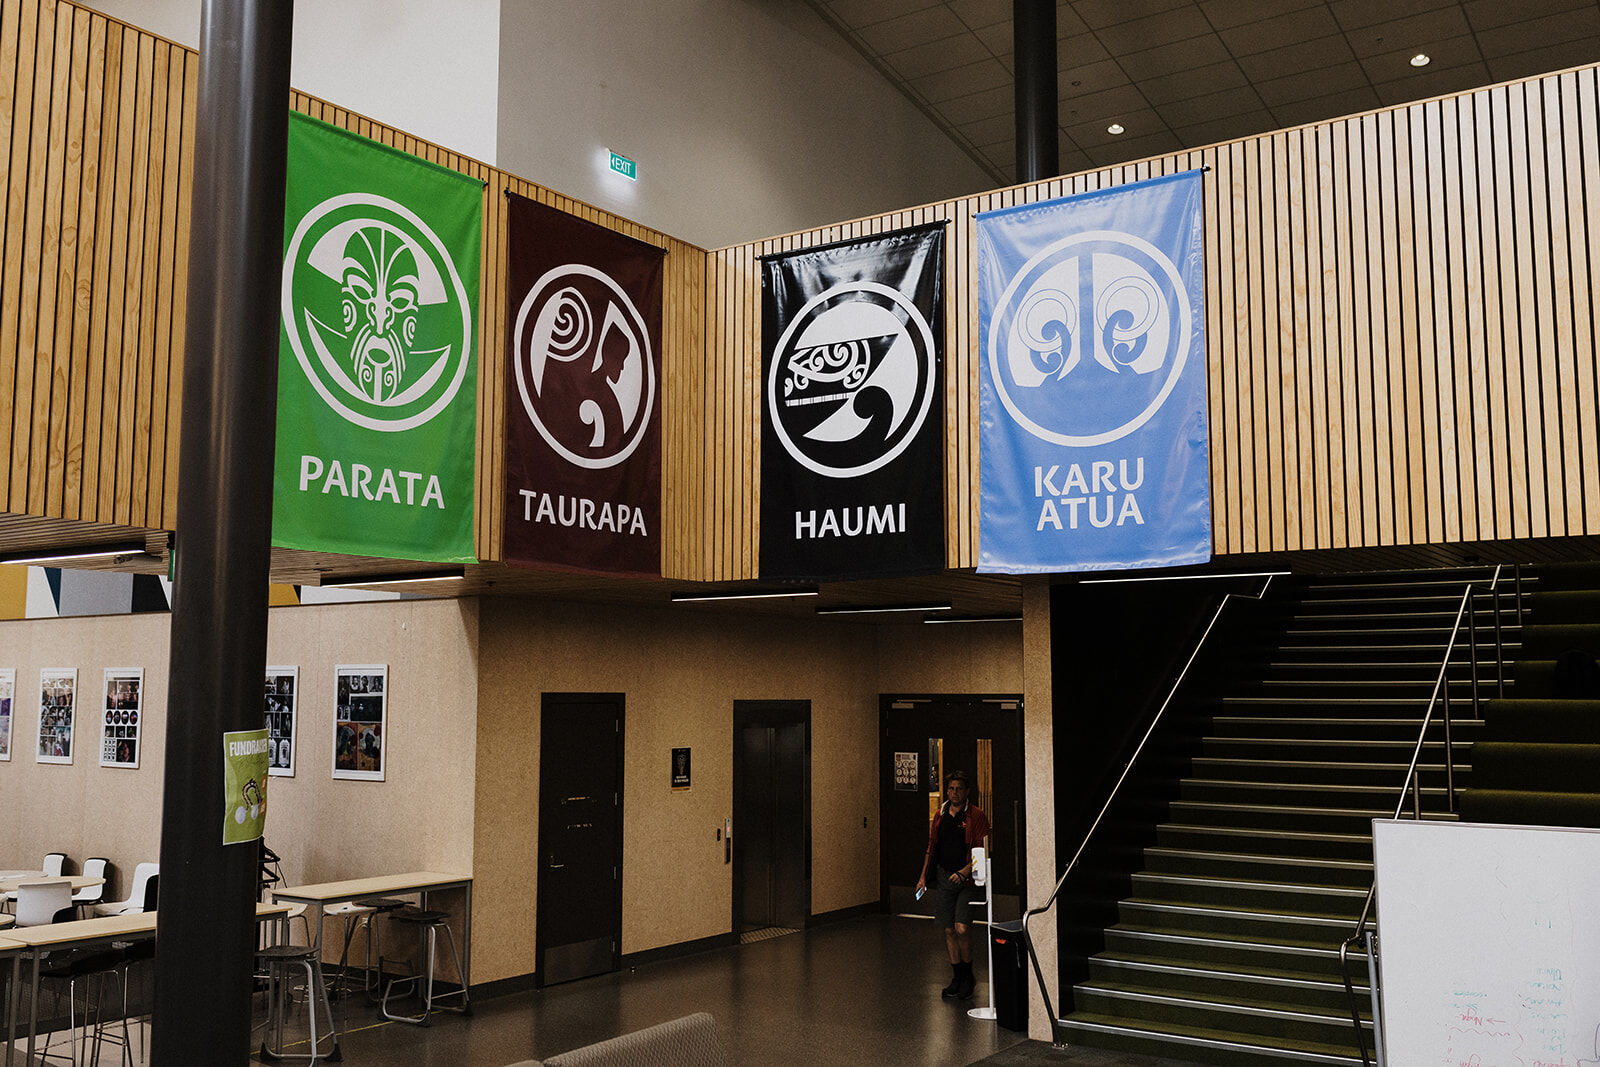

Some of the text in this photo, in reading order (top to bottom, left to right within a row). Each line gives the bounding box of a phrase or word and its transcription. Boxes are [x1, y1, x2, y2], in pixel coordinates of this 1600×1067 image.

[616, 158, 631, 175] EXIT
[299, 455, 446, 510] PARATA
[1034, 457, 1144, 497] KARU
[518, 488, 649, 537] TAURAPA
[794, 502, 907, 539] HAUMI
[1036, 493, 1145, 532] ATUA
